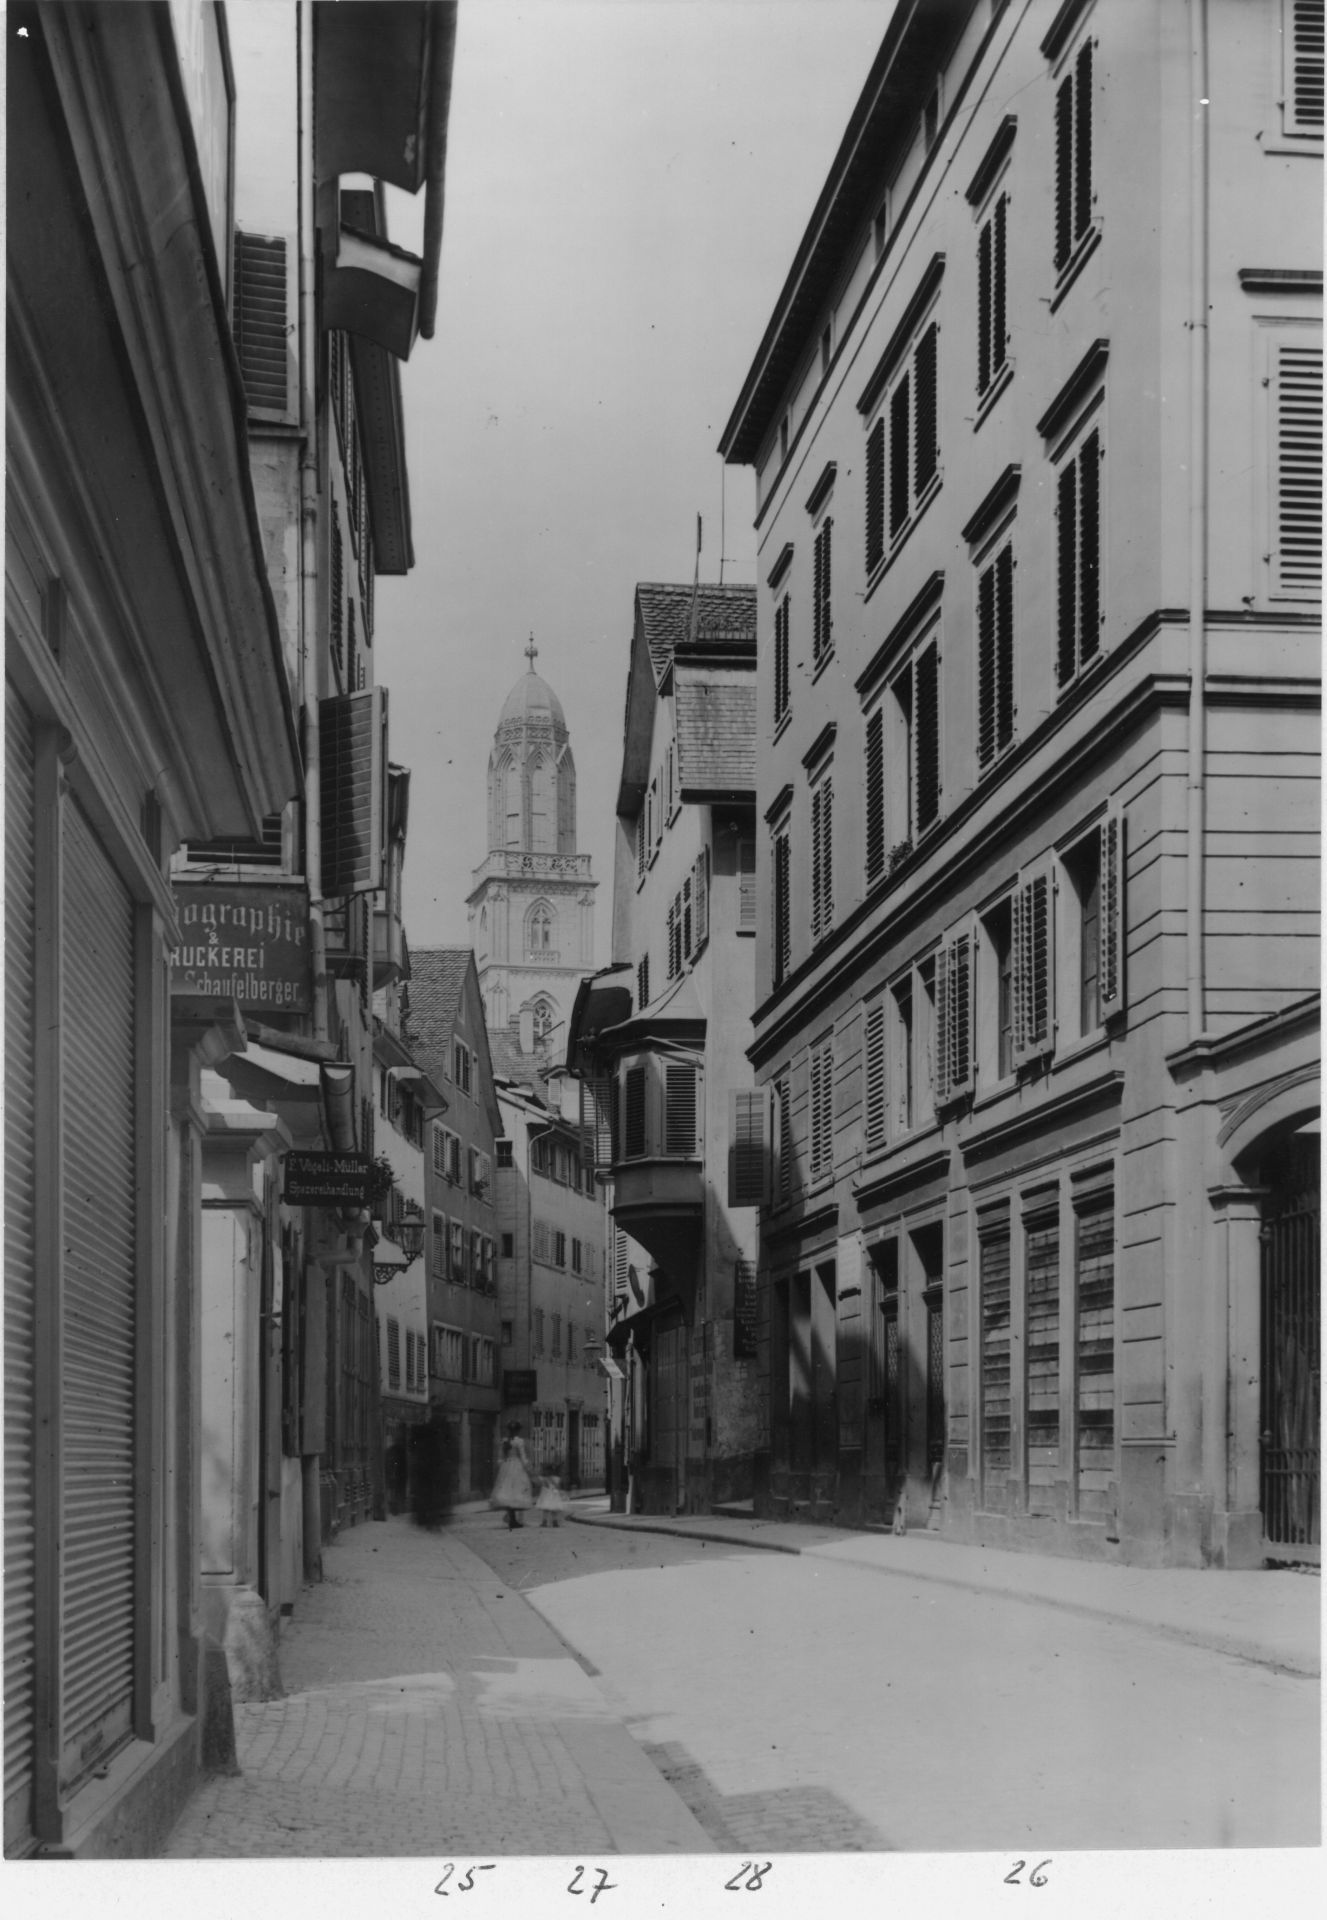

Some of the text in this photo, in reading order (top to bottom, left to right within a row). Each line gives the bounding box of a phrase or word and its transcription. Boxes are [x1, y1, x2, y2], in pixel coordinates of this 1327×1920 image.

[208, 932, 219, 945] &
[434, 1859, 1053, 1904] 25 27 28 26
